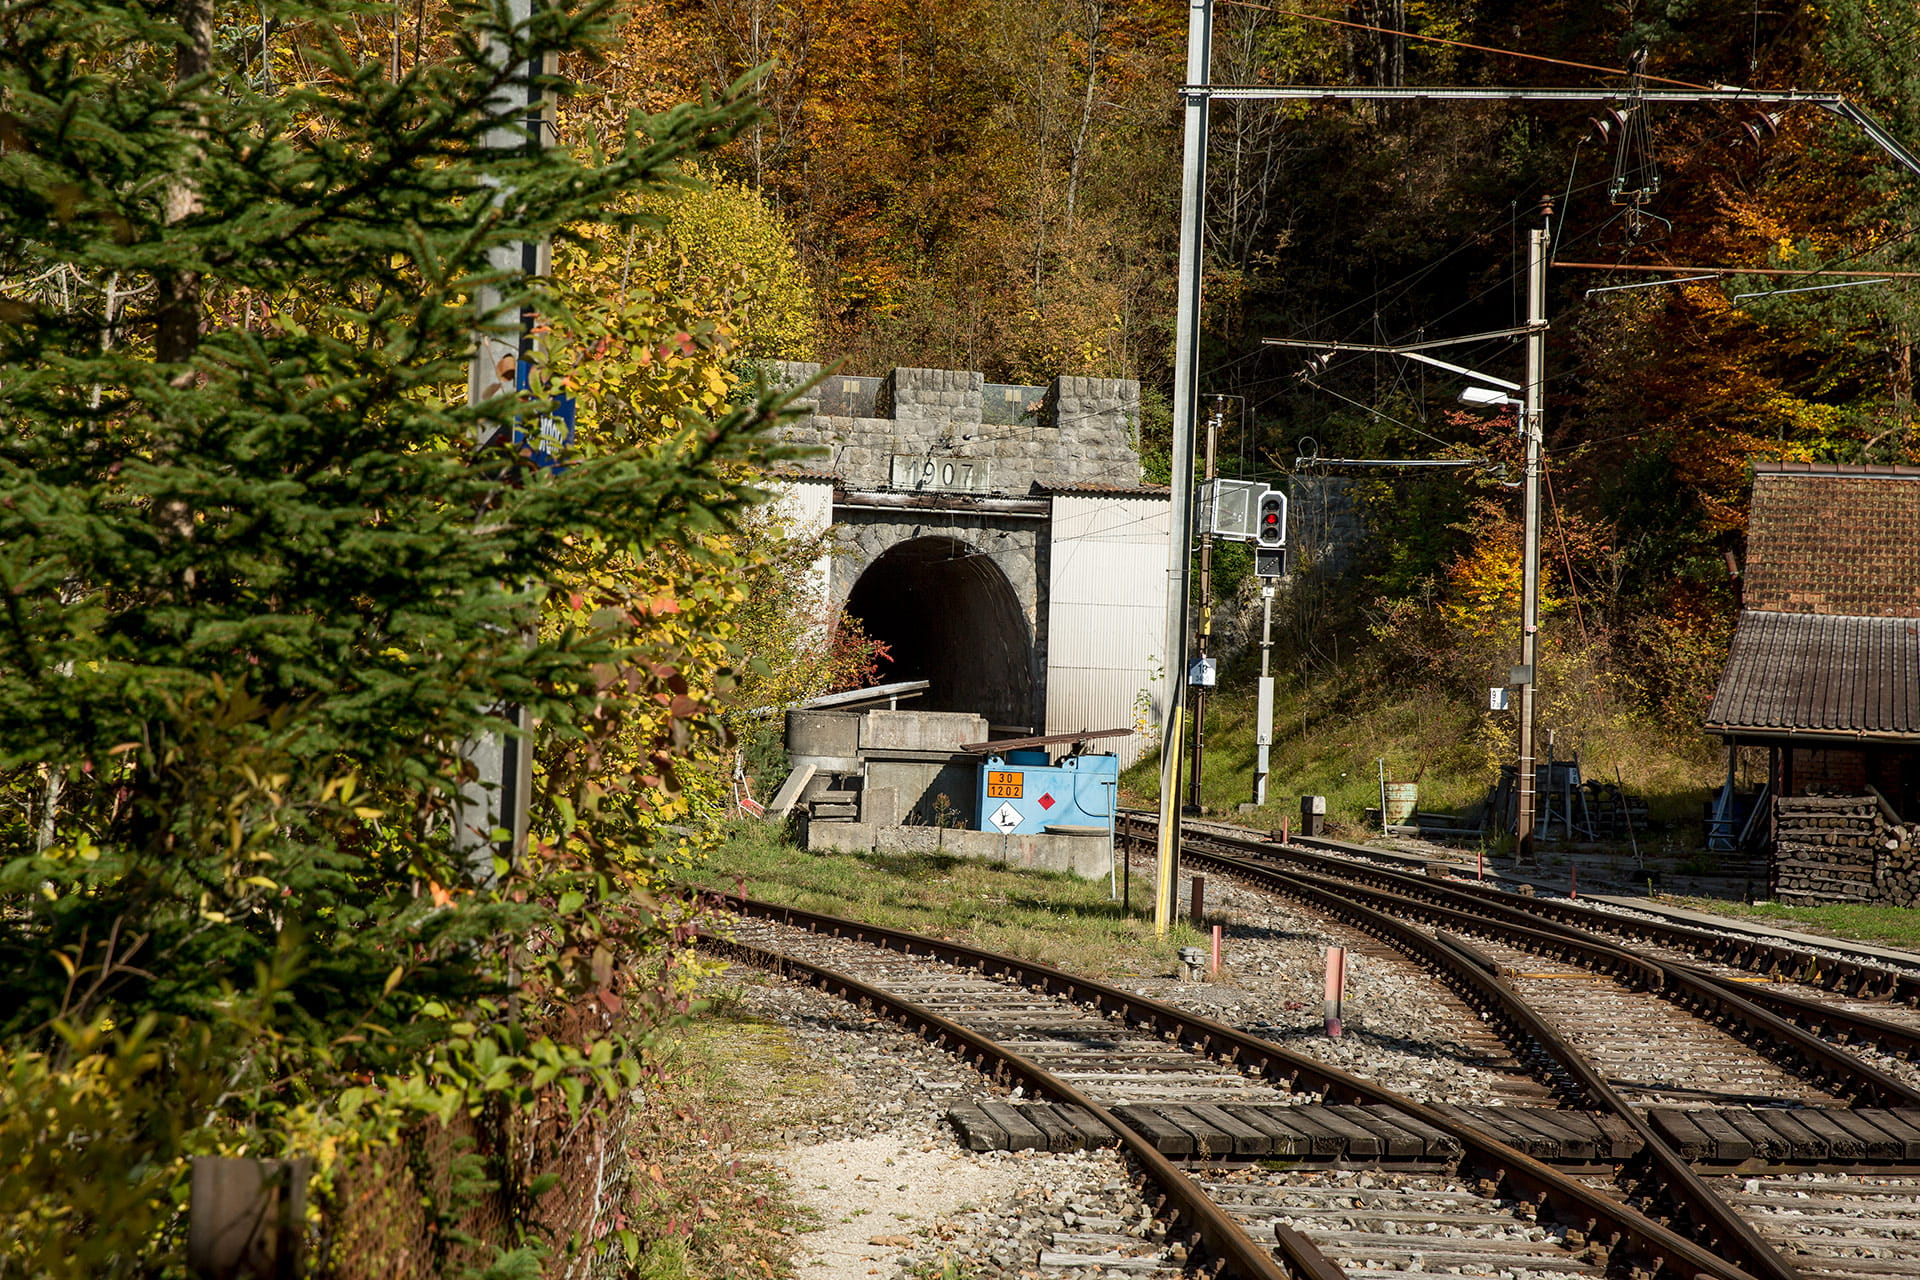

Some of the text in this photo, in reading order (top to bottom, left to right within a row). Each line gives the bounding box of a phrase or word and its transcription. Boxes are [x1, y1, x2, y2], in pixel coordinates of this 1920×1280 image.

[908, 460, 974, 487] 1907
[999, 773, 1013, 783] 30
[991, 786, 1020, 796] 1202
